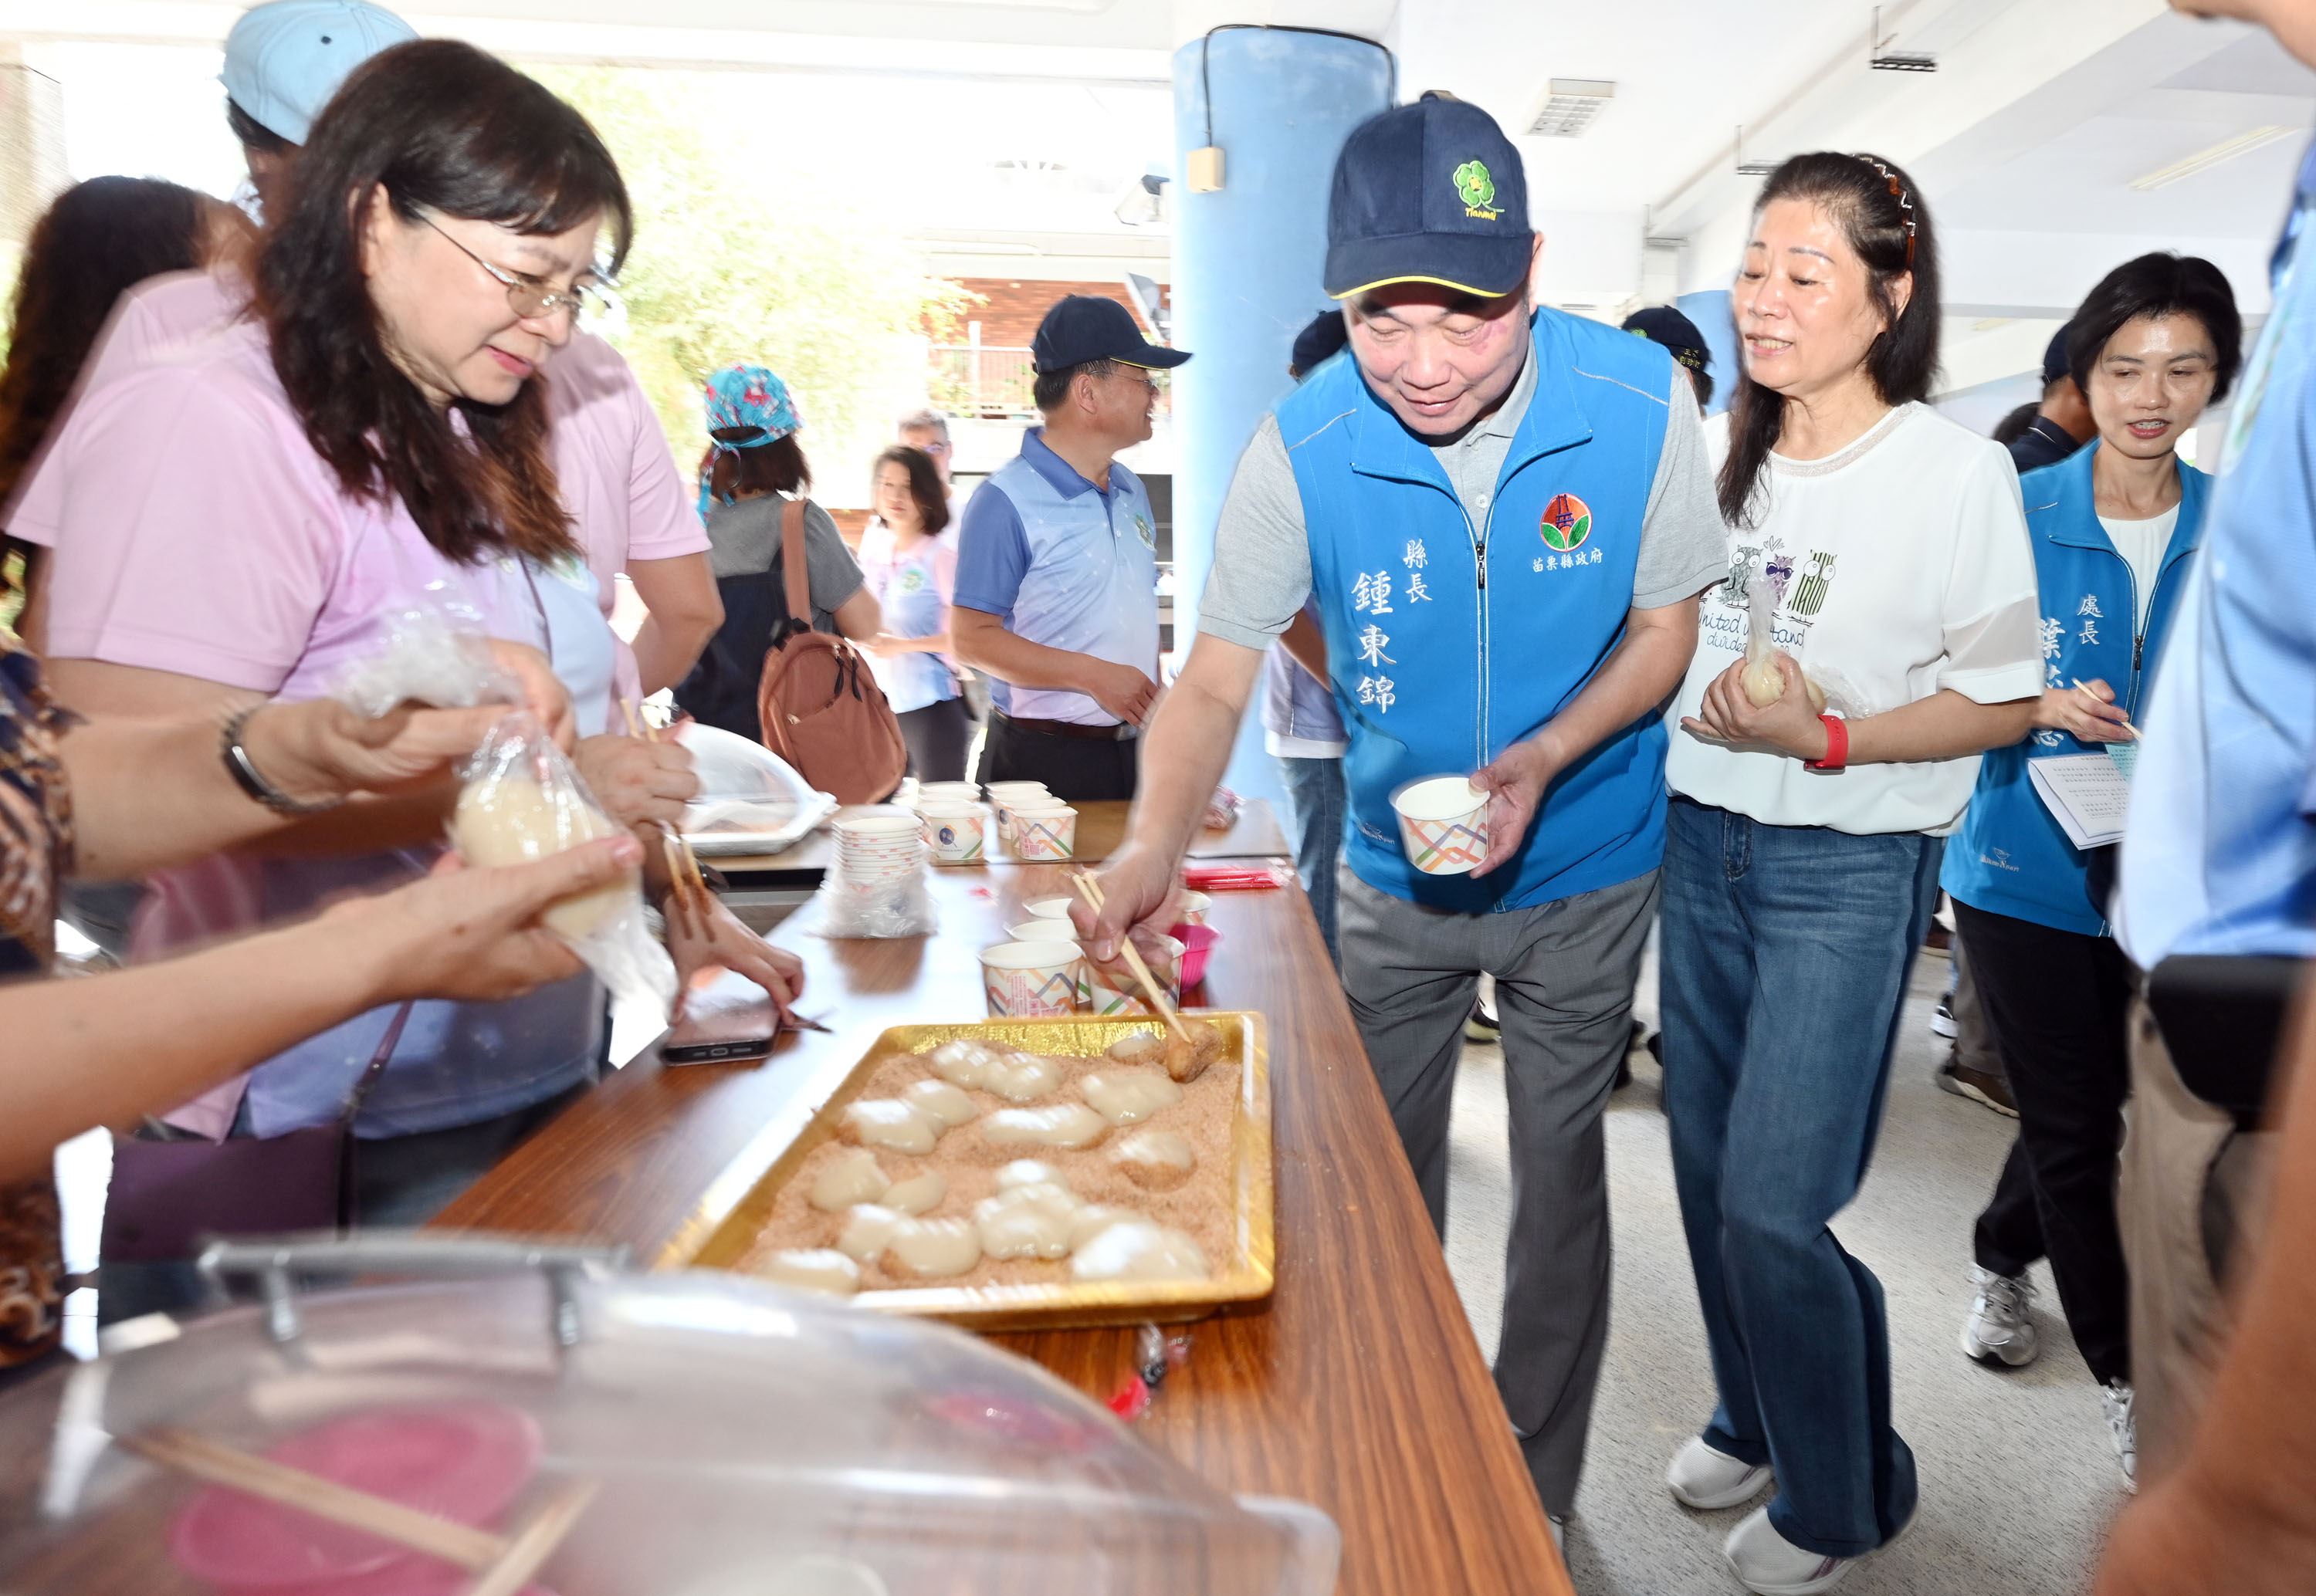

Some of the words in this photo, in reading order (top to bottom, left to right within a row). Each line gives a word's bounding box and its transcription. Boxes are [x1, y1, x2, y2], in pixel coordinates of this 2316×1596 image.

[1402, 538, 1433, 604] 縣長
[1532, 547, 1603, 573] 苗栗縣政府
[1351, 570, 1397, 715] 鍾東錦
[1769, 623, 1806, 649] tand
[2077, 593, 2104, 645] 處長
